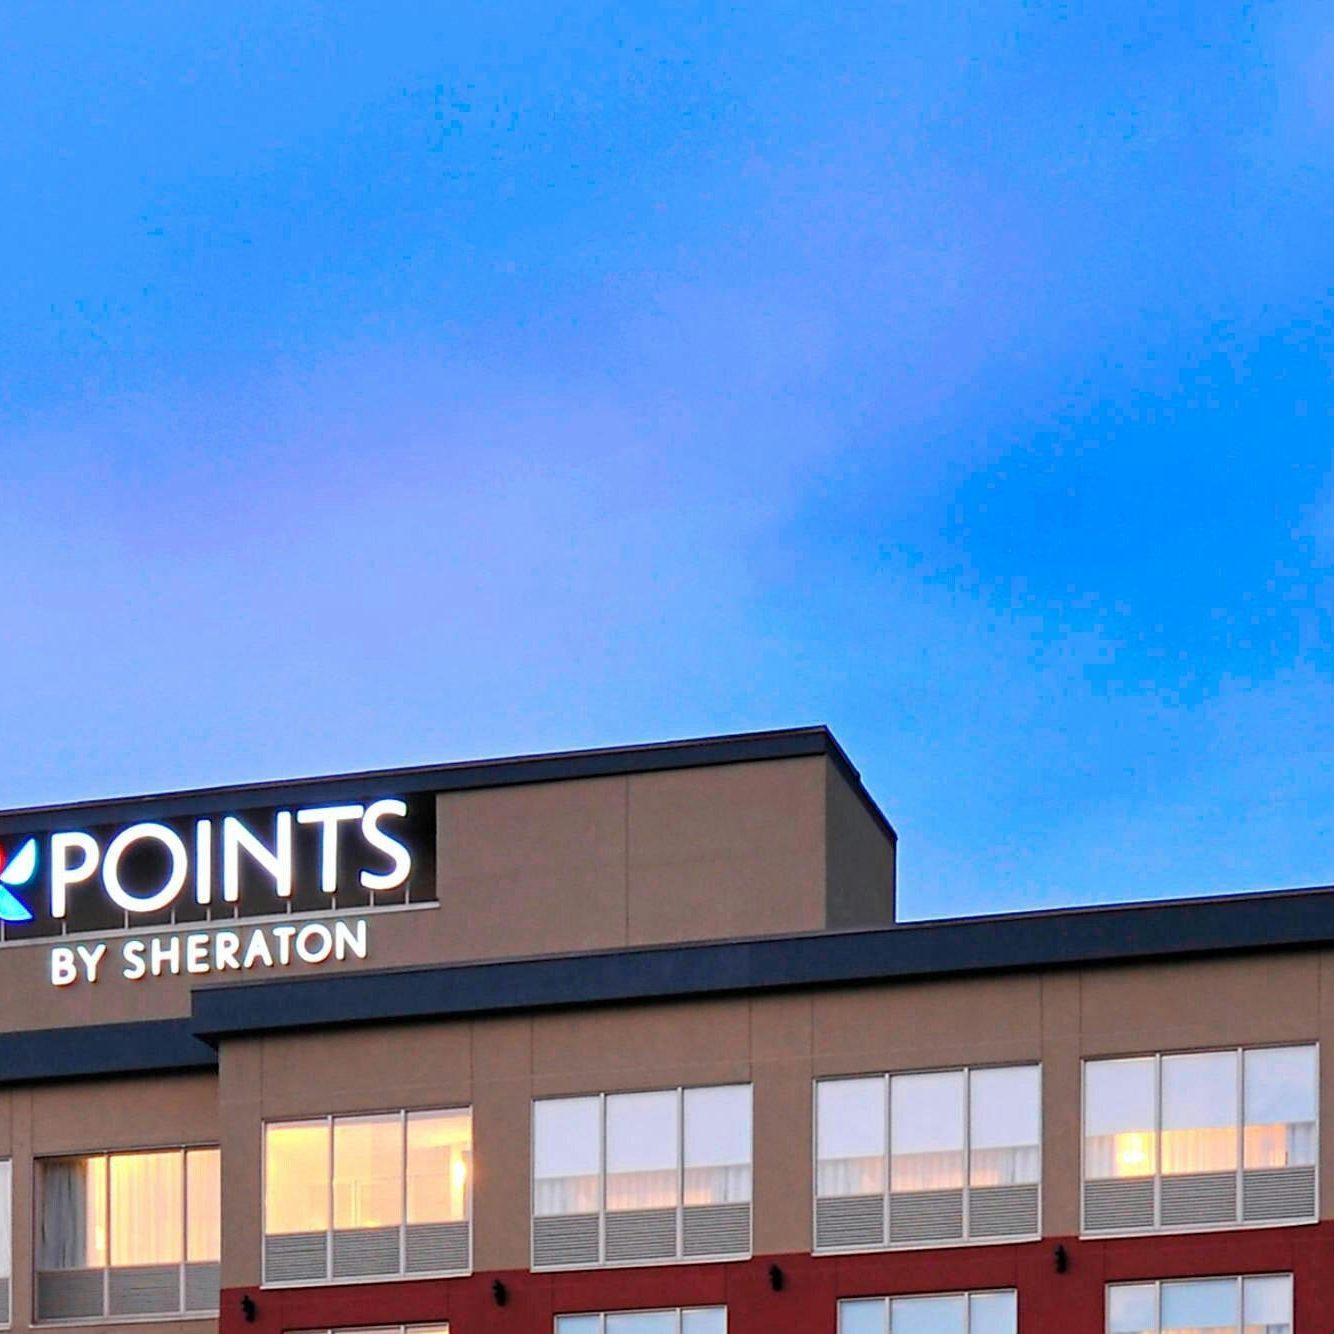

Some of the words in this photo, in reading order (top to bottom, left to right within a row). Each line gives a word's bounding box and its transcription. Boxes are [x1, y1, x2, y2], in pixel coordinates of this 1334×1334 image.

[49, 798, 412, 919] POINTS
[50, 943, 107, 986] BY
[122, 919, 368, 980] SHERATON
